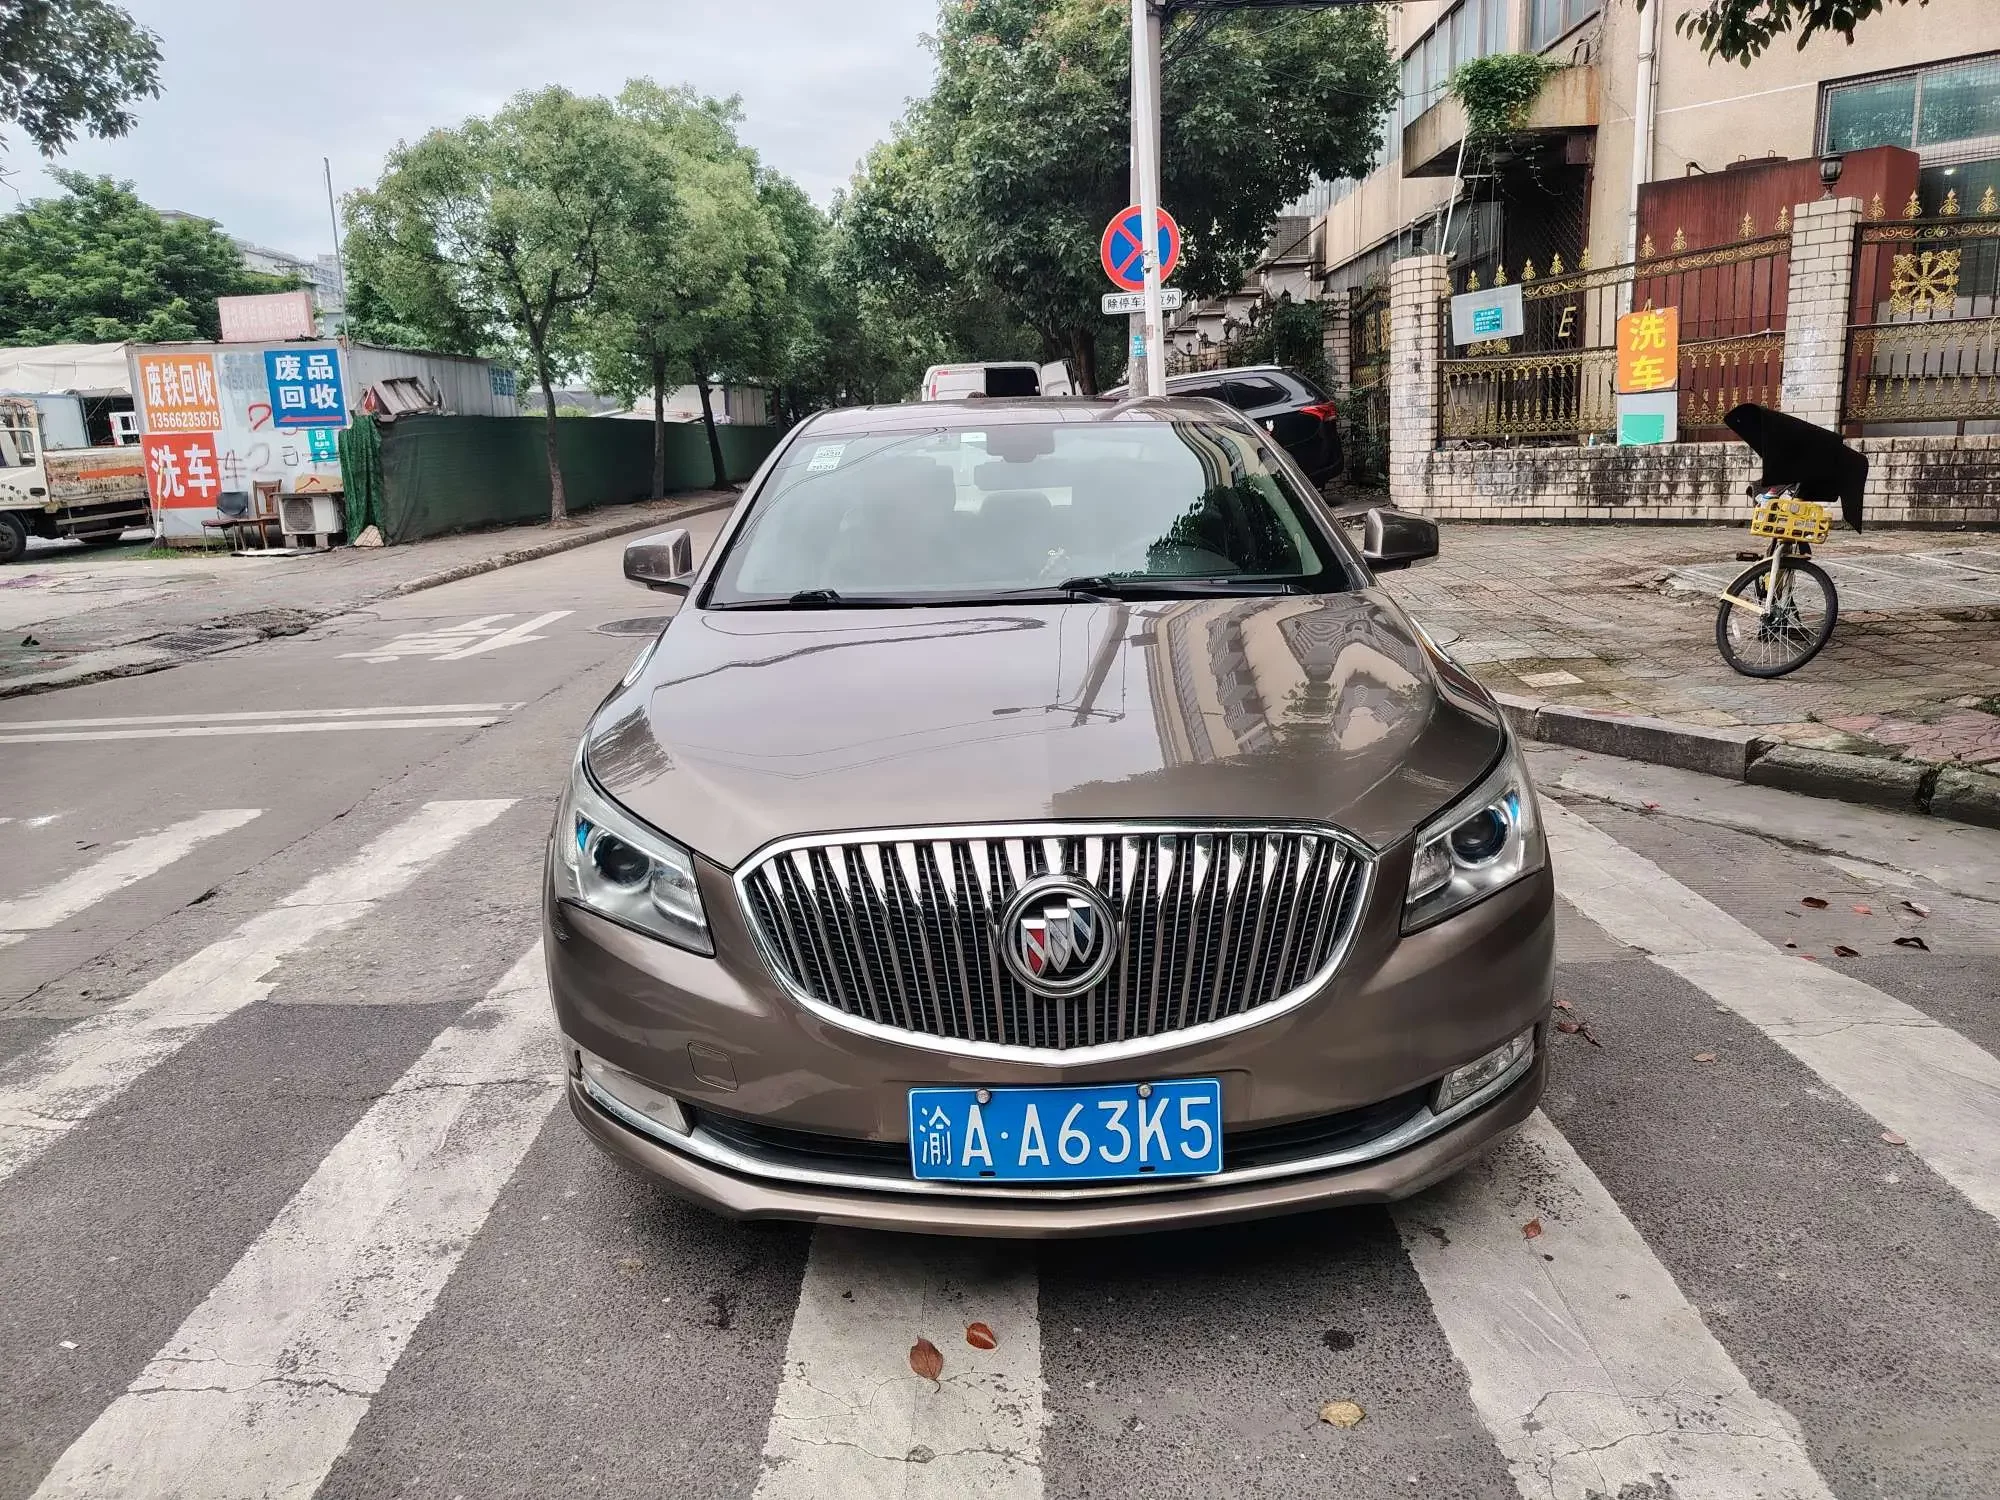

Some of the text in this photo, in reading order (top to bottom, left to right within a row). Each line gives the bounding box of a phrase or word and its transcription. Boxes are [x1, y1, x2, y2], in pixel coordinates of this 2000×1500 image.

[1107, 292, 1177, 310] 除停车外
[275, 354, 335, 381] 废品
[1629, 314, 1666, 390] 洗车
[145, 361, 216, 408] 废铁回收
[278, 383, 340, 410] 回收
[150, 410, 220, 428] 13566235876
[150, 443, 217, 499] 洗车
[919, 1096, 1213, 1167] 渝A·A63K5
